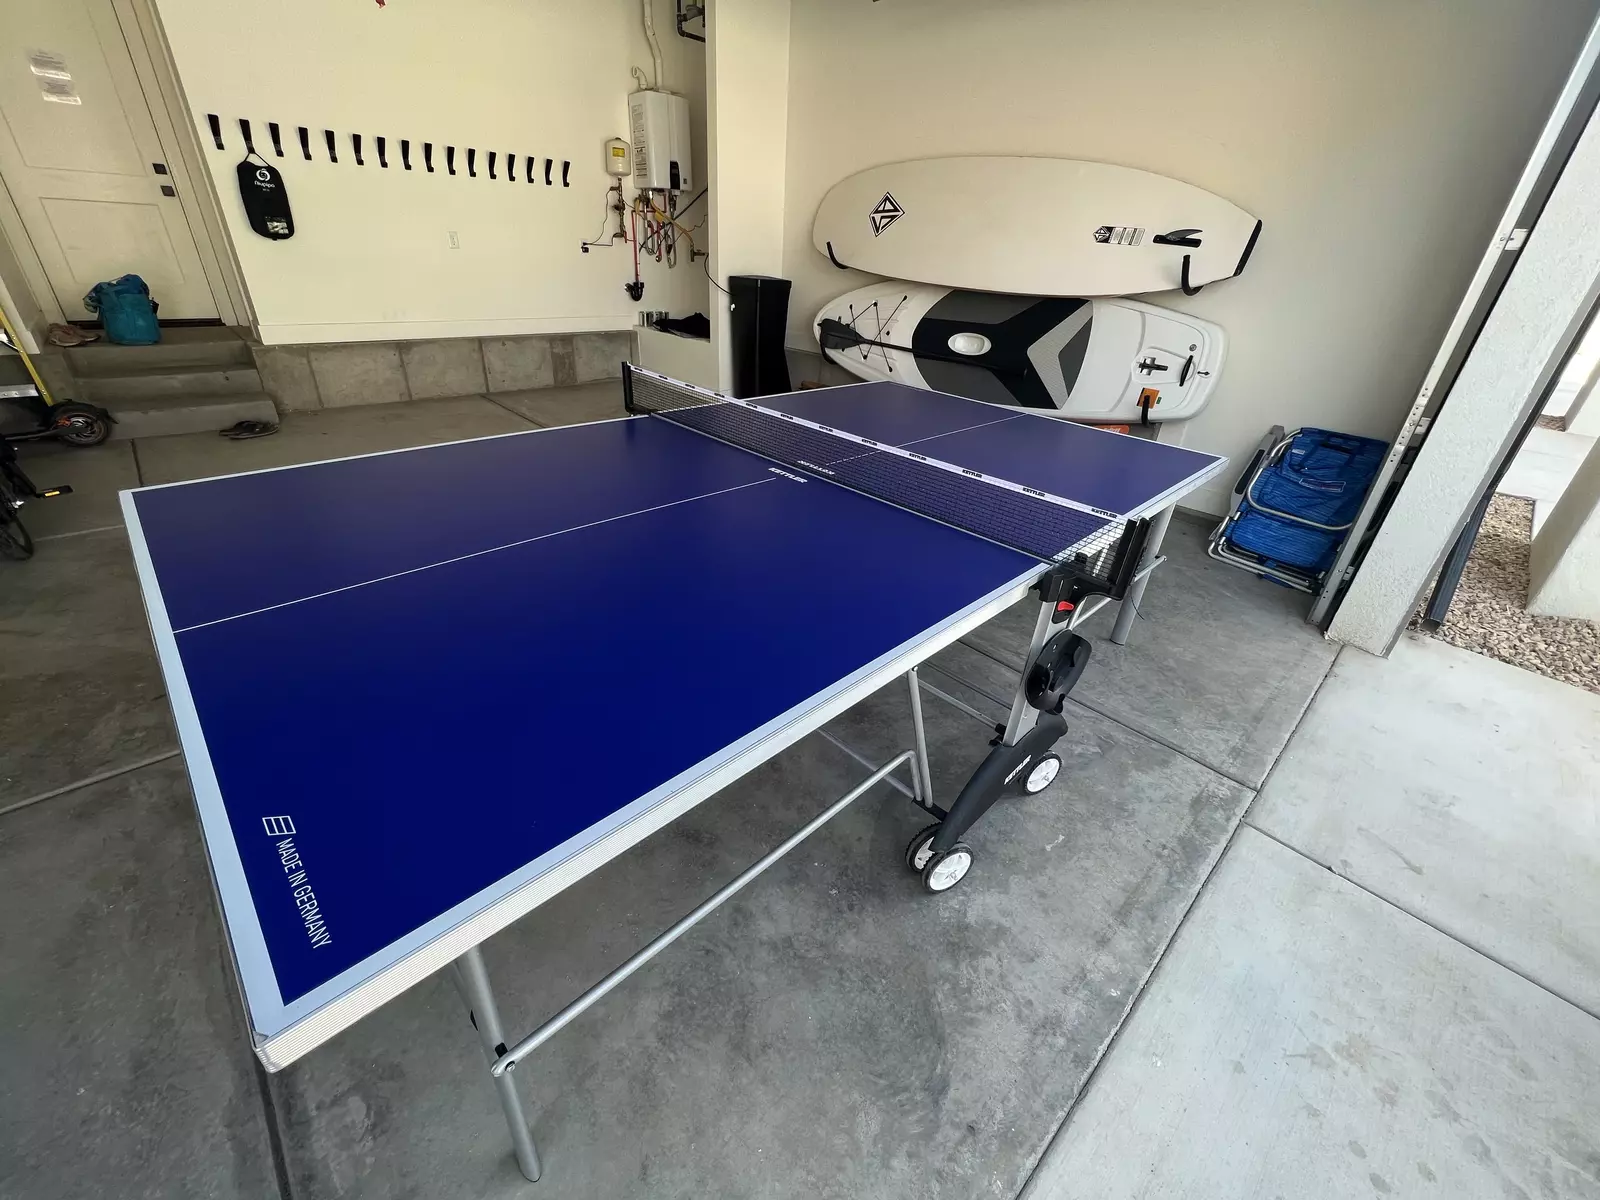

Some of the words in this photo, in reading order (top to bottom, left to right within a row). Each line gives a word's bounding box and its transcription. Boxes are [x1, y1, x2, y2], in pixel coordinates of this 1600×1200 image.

[908, 453, 927, 462] KETTLER
[768, 467, 808, 483] KETTLER
[961, 468, 983, 479] KETTLER
[1022, 487, 1046, 498] KETTLER
[1091, 507, 1118, 519] KETTLER
[276, 837, 303, 873] MADE
[287, 869, 308, 888] IN
[293, 885, 332, 949] GERMANY
